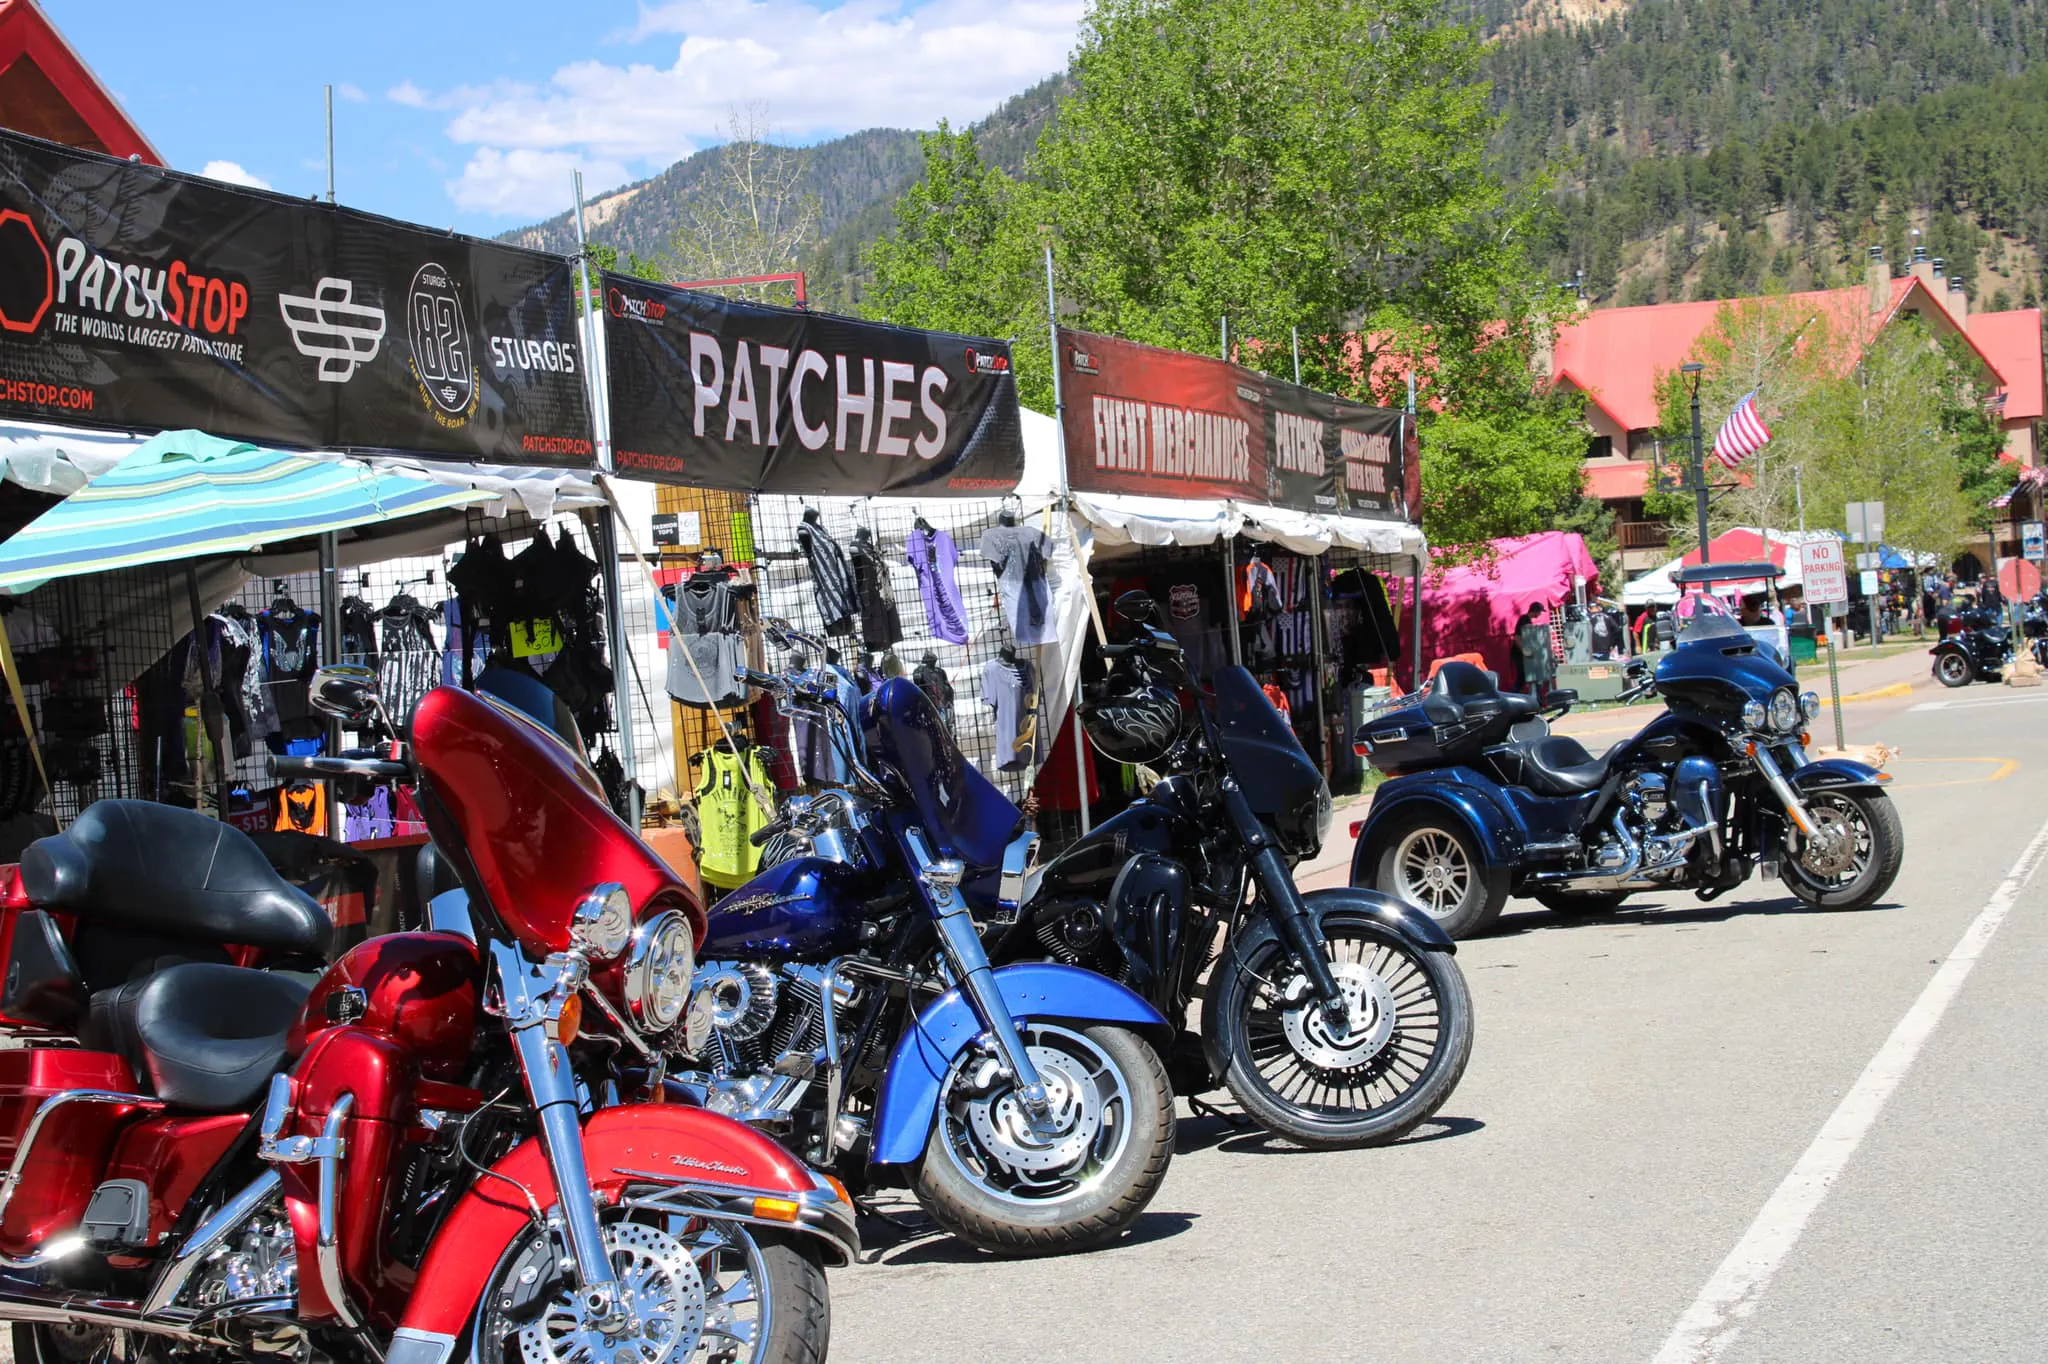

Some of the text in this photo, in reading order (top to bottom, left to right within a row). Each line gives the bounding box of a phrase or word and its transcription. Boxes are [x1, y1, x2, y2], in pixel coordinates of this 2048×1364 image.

[56, 237, 248, 335] PATCHSTOP
[422, 274, 448, 288] STURGIS
[55, 312, 243, 362] THE WORLDS LARGEST PATCH STORE
[414, 292, 468, 384] 82
[491, 336, 575, 374] STURGIS
[689, 332, 949, 460] PATCHES
[523, 434, 593, 455] PATCHSTOP.COM
[1092, 395, 1250, 484] EVENT MERCHANDISE
[1275, 410, 1325, 478] PATCHES
[616, 450, 684, 473] PATCHSTOP.COM
[1804, 561, 1841, 574] PARKING
[1811, 547, 1829, 560] NO
[1807, 586, 1841, 596] THIS POINT
